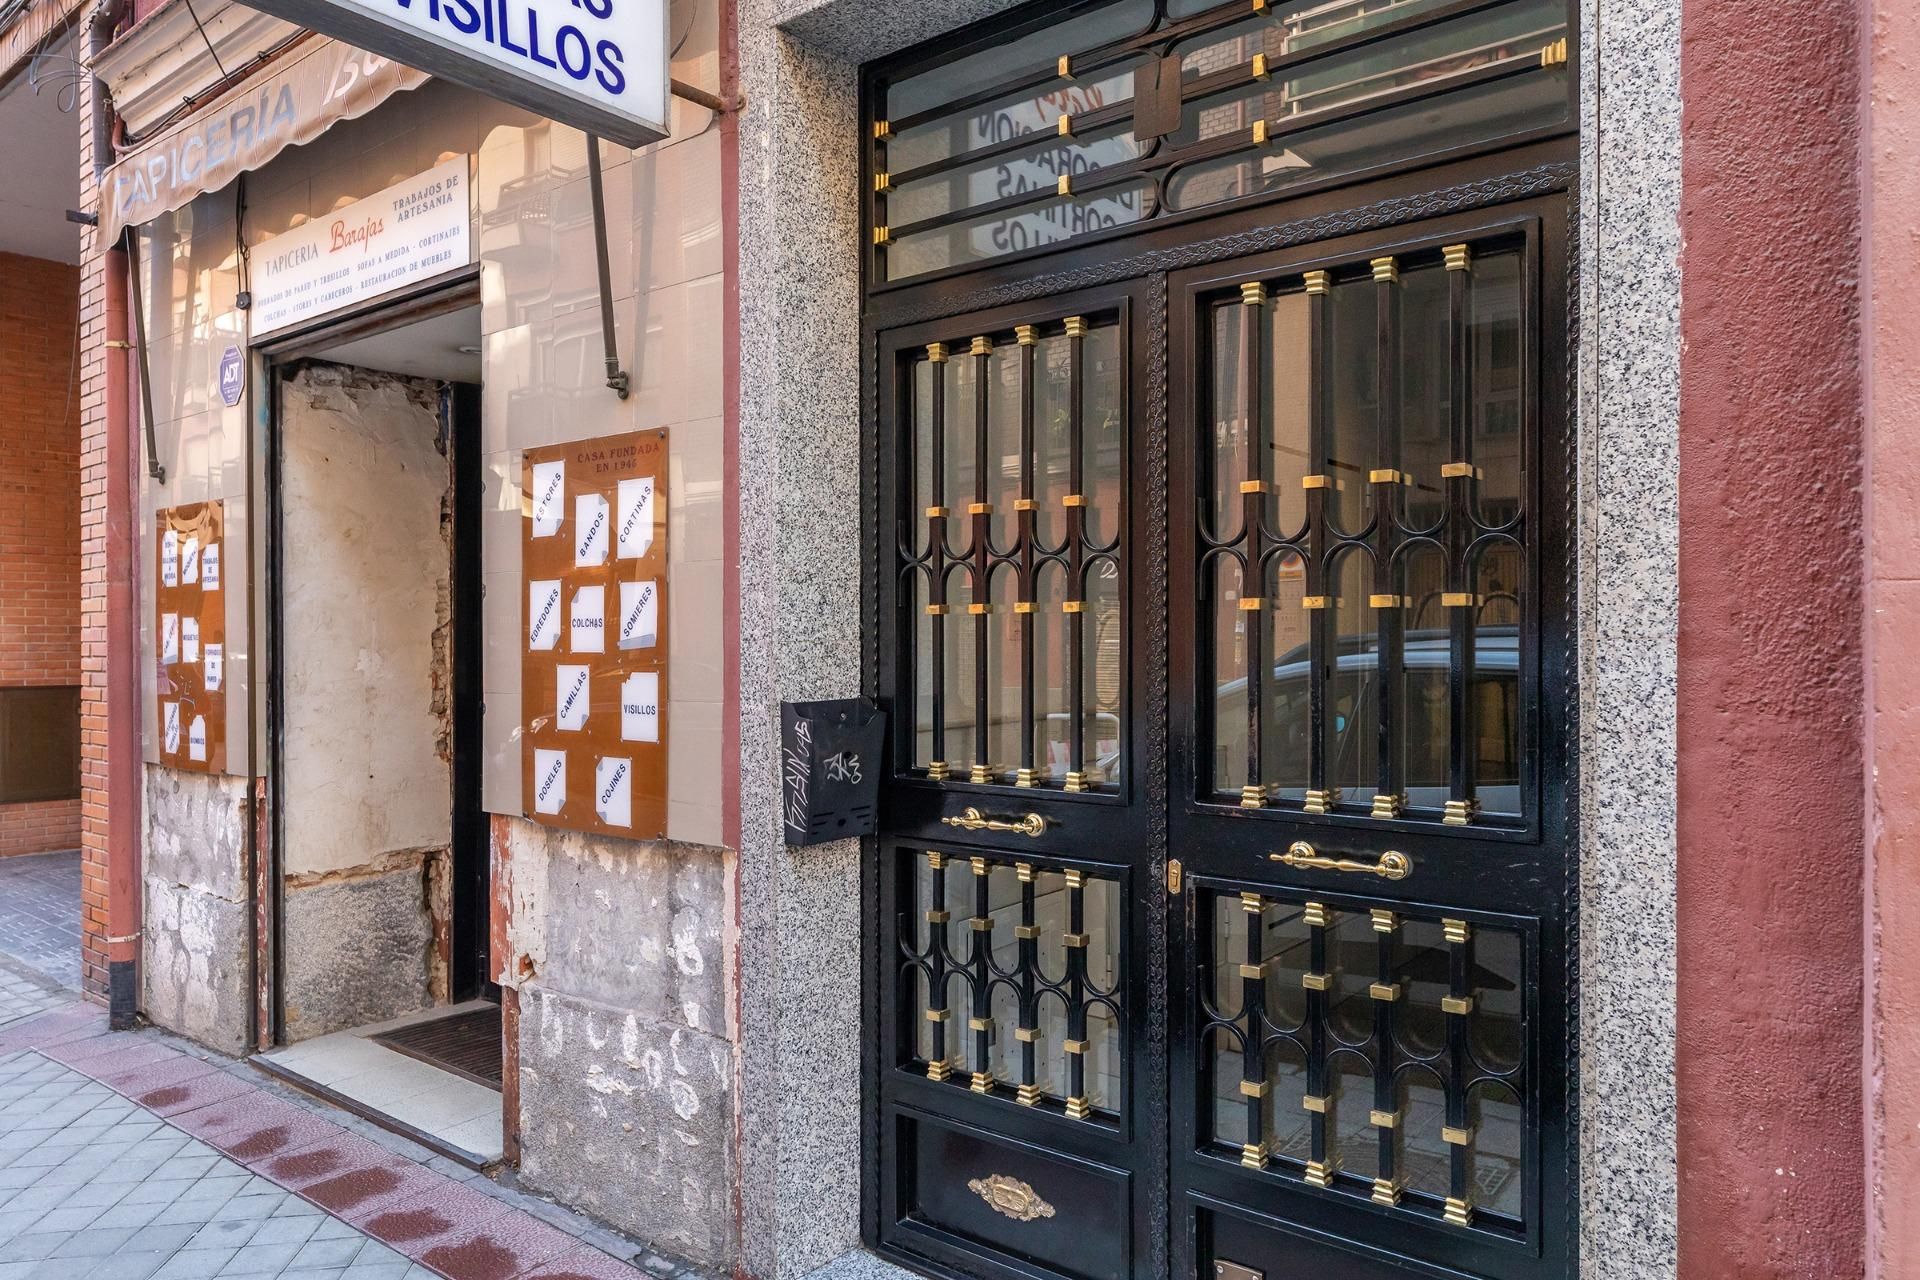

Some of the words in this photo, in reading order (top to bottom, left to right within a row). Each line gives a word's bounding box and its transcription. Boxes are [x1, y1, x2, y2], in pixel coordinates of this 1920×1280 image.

[393, 182, 441, 211] TRABAJOS
[446, 175, 458, 189] DE
[397, 193, 453, 222] ARTESANIA
[266, 243, 318, 276] TAPICERIA
[330, 217, 384, 253] Barajas
[385, 246, 409, 261] MEDIDA
[409, 260, 417, 272] DE
[421, 249, 452, 268] MUEBLES
[222, 361, 240, 385] ADT
[577, 451, 605, 464] CASA
[610, 442, 660, 459] FUNDADA
[596, 462, 609, 473] EN
[535, 472, 562, 522] ESTORES
[620, 486, 652, 543] CORTINAS
[580, 512, 605, 557] BANDOS
[530, 588, 559, 642] EDREDONES
[571, 618, 603, 628] COLCHAS
[623, 586, 653, 637] SOMIERES
[560, 671, 587, 719] CAMILLAS
[623, 704, 656, 716] VISILLOS
[538, 759, 562, 802] DOSELES
[601, 763, 627, 804] COJINES
